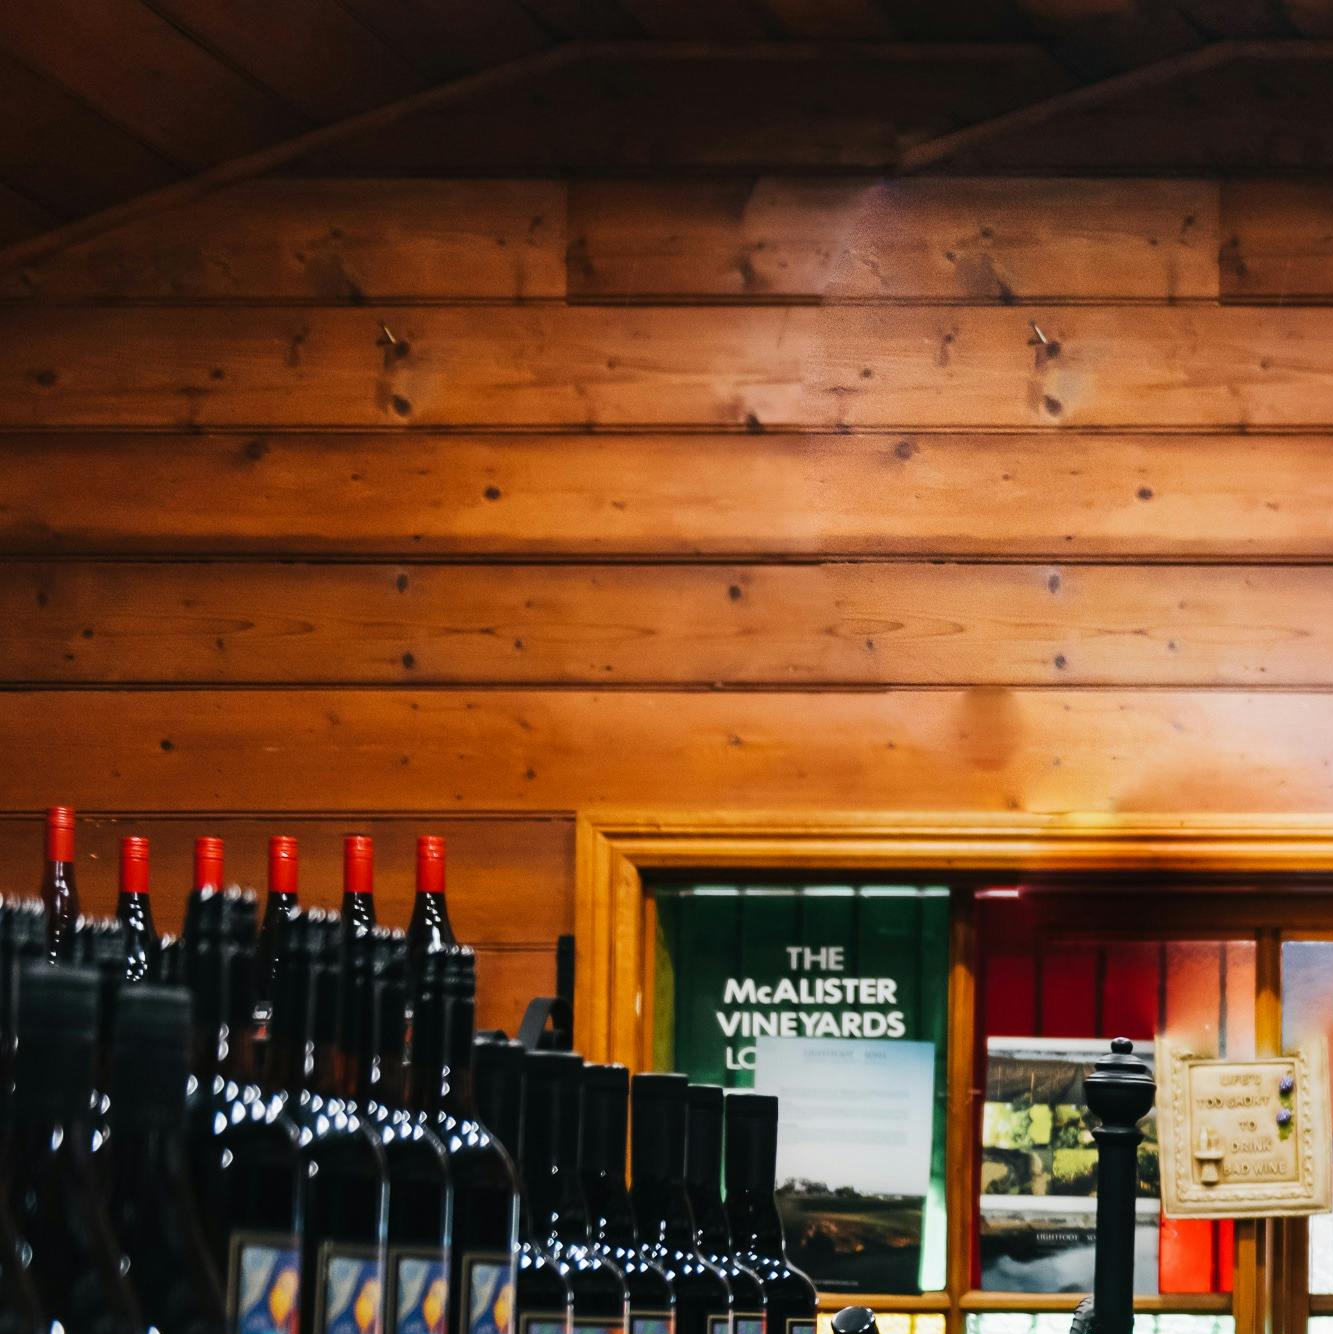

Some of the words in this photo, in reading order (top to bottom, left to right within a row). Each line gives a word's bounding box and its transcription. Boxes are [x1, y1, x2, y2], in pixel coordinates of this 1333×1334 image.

[786, 946, 844, 971] THE
[723, 978, 898, 1004] McALISTER
[716, 1010, 907, 1037] VINEYARDS
[725, 1046, 757, 1071] LO
[1238, 1120, 1257, 1132] TO
[1232, 1138, 1273, 1154] DRINK
[1253, 1161, 1287, 1176] WINE
